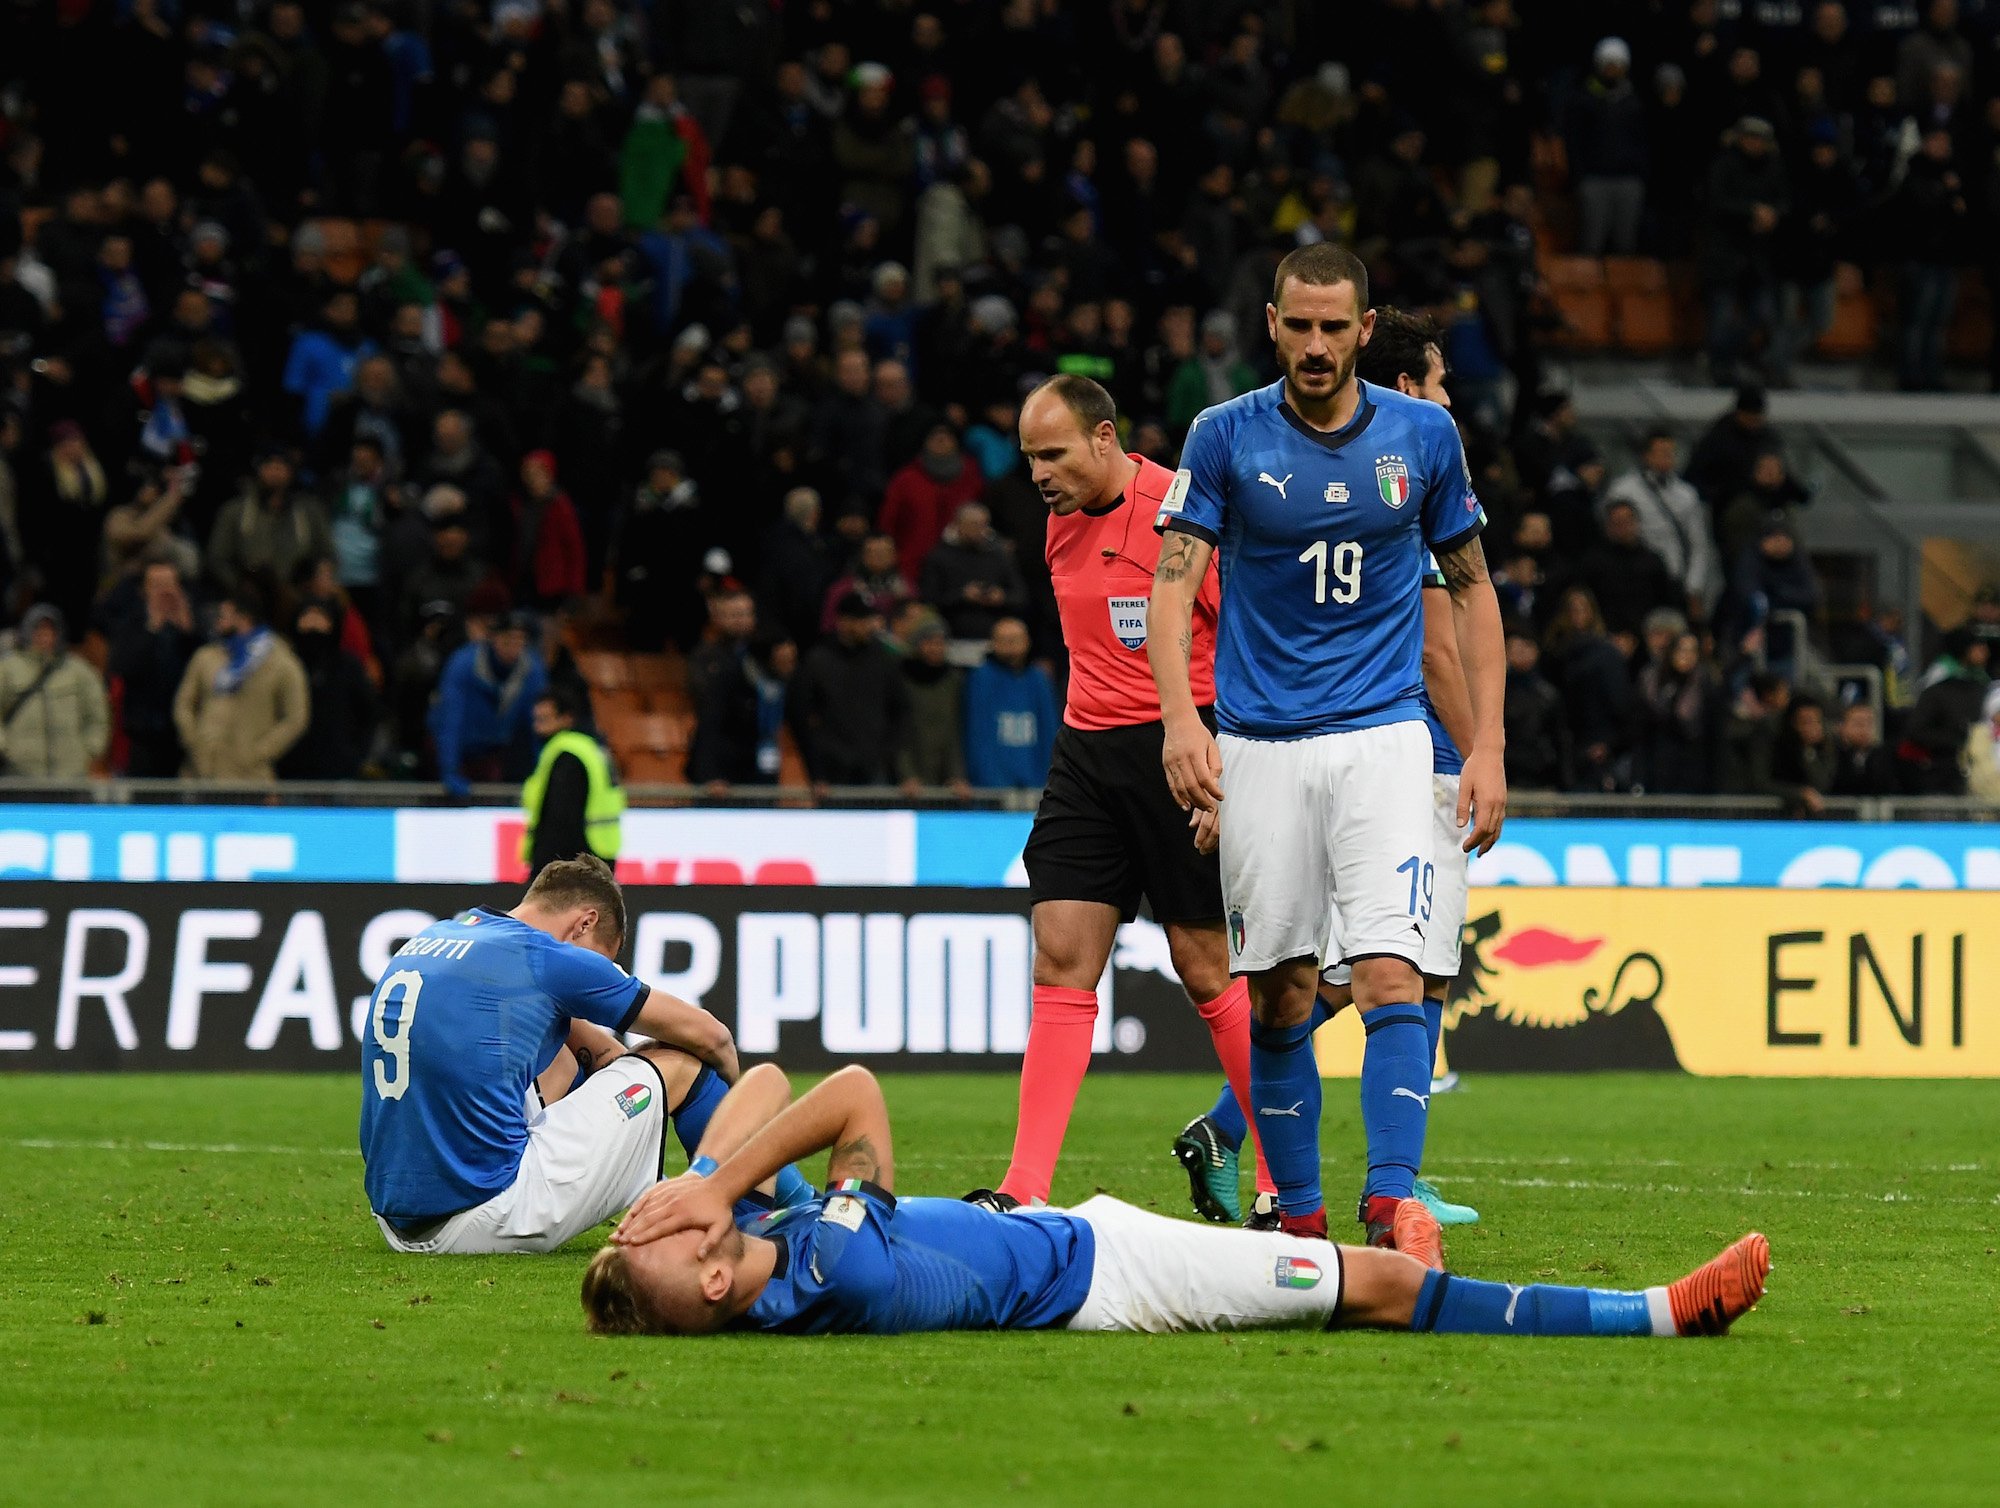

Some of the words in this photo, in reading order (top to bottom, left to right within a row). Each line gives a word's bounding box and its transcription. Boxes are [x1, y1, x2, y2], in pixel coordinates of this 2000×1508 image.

[1379, 466, 1404, 476] ITALIA
[1111, 600, 1146, 608] REFEREE
[1298, 540, 1364, 605] 19
[1119, 619, 1143, 628] FIFA
[1396, 855, 1435, 922] 19
[737, 912, 1114, 1054] PUM
[1766, 930, 1965, 1048] ENI
[373, 969, 424, 1101] 9
